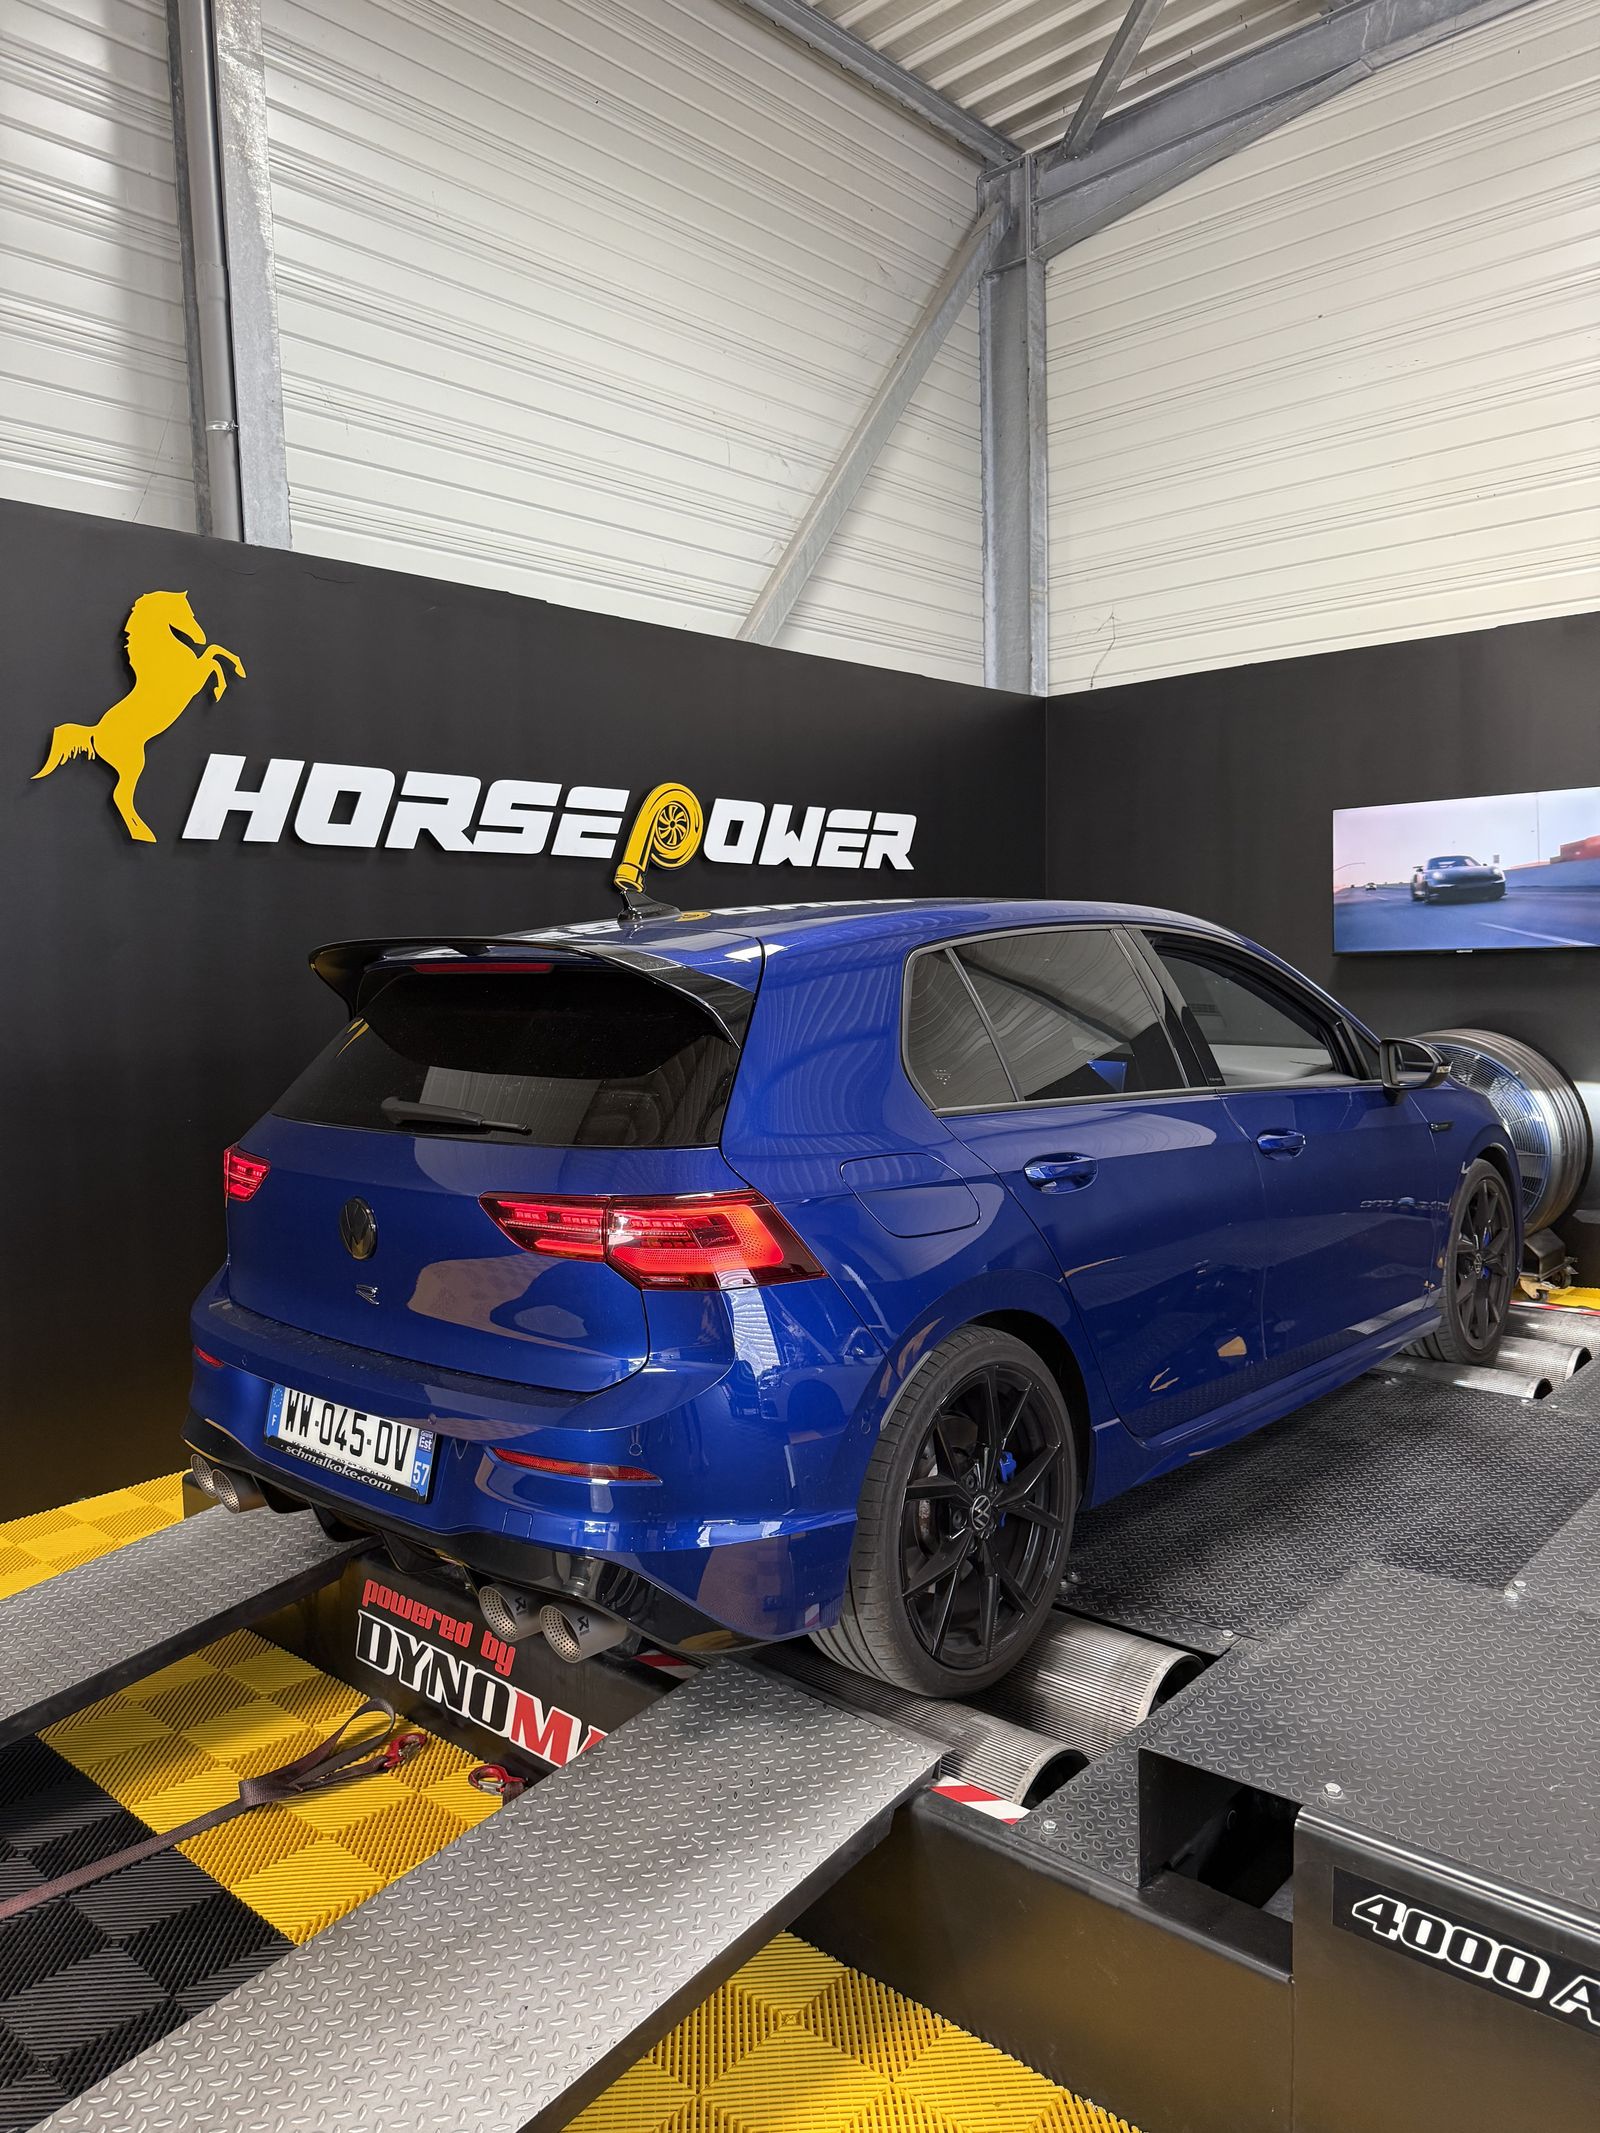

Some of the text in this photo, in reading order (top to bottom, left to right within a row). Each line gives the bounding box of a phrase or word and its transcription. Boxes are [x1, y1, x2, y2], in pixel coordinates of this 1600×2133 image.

[271, 1414, 278, 1426] F
[418, 1435, 432, 1450] Est
[285, 1446, 392, 1491] schmalkoke.com
[412, 1460, 430, 1486] 57
[361, 1578, 516, 1676] powered by
[1352, 1894, 1550, 1999] 4000
